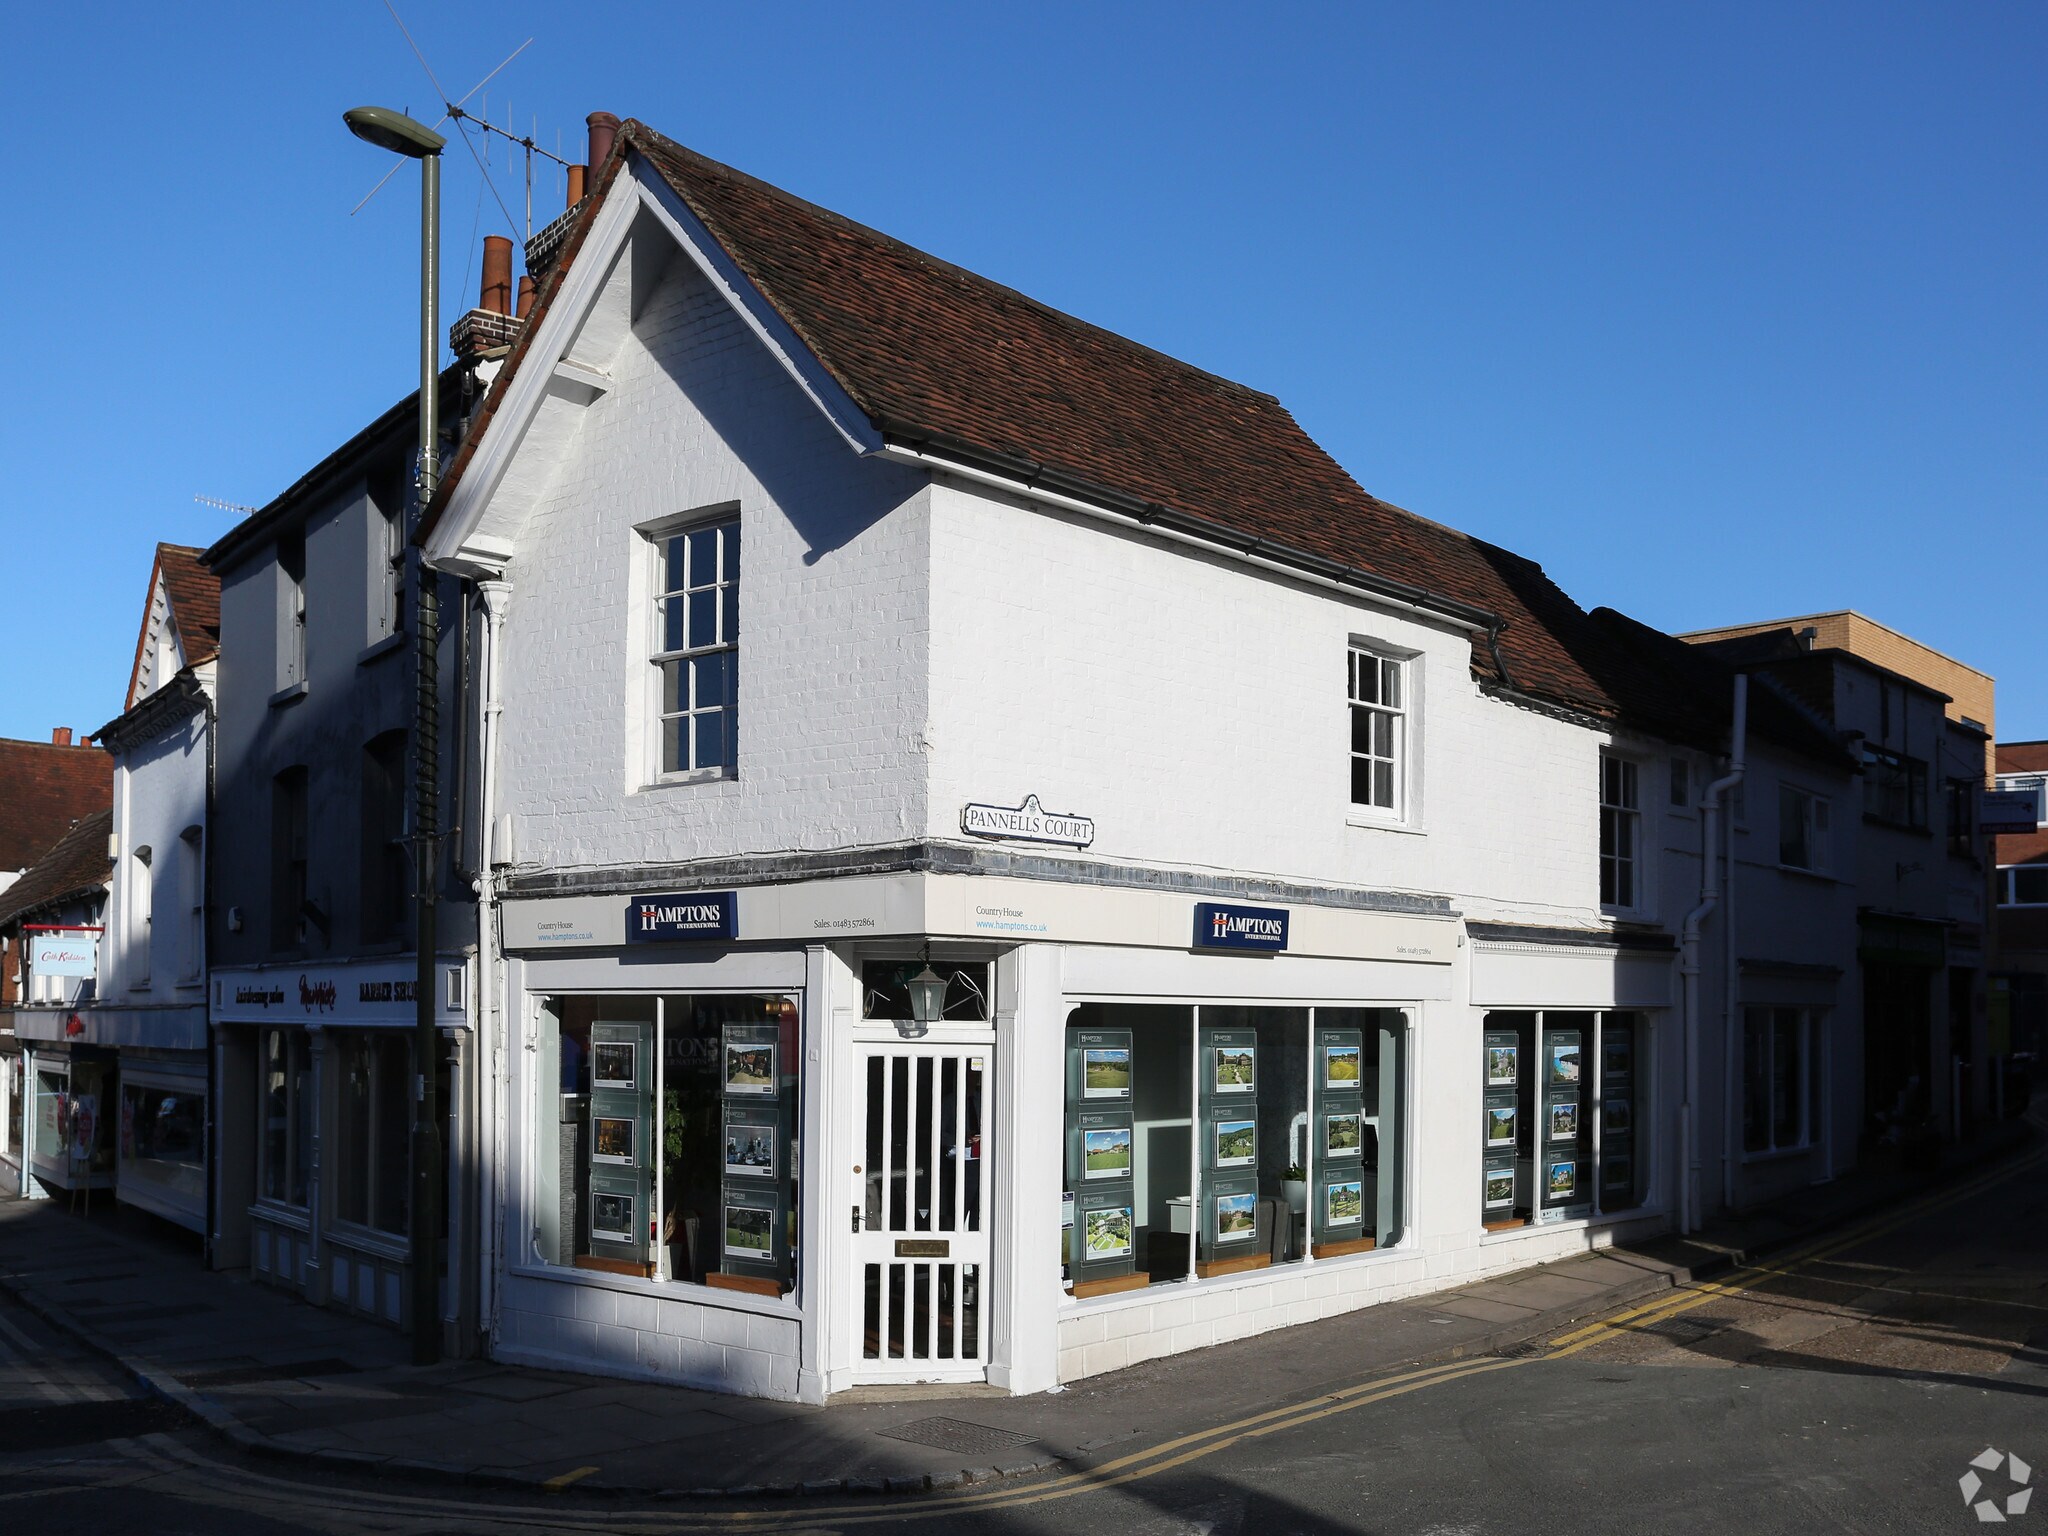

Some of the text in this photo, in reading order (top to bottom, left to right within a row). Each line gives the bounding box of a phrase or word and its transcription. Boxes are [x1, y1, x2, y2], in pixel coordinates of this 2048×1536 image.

[970, 810, 1089, 838] PANNELLS COURT
[640, 904, 720, 931] HAMPTONS
[976, 905, 1023, 918] Country House
[537, 921, 573, 931] Country House
[676, 921, 721, 930] INTERNATIONAL
[813, 918, 875, 929] Sales. 01483 572864
[976, 920, 1048, 932] www.hamptons.co.uk
[1213, 912, 1282, 938] HAMPTONS
[538, 932, 594, 942] www.hamptons.co.uk
[1244, 933, 1281, 942] INTERNATIONAL
[359, 982, 392, 1002] BARBER
